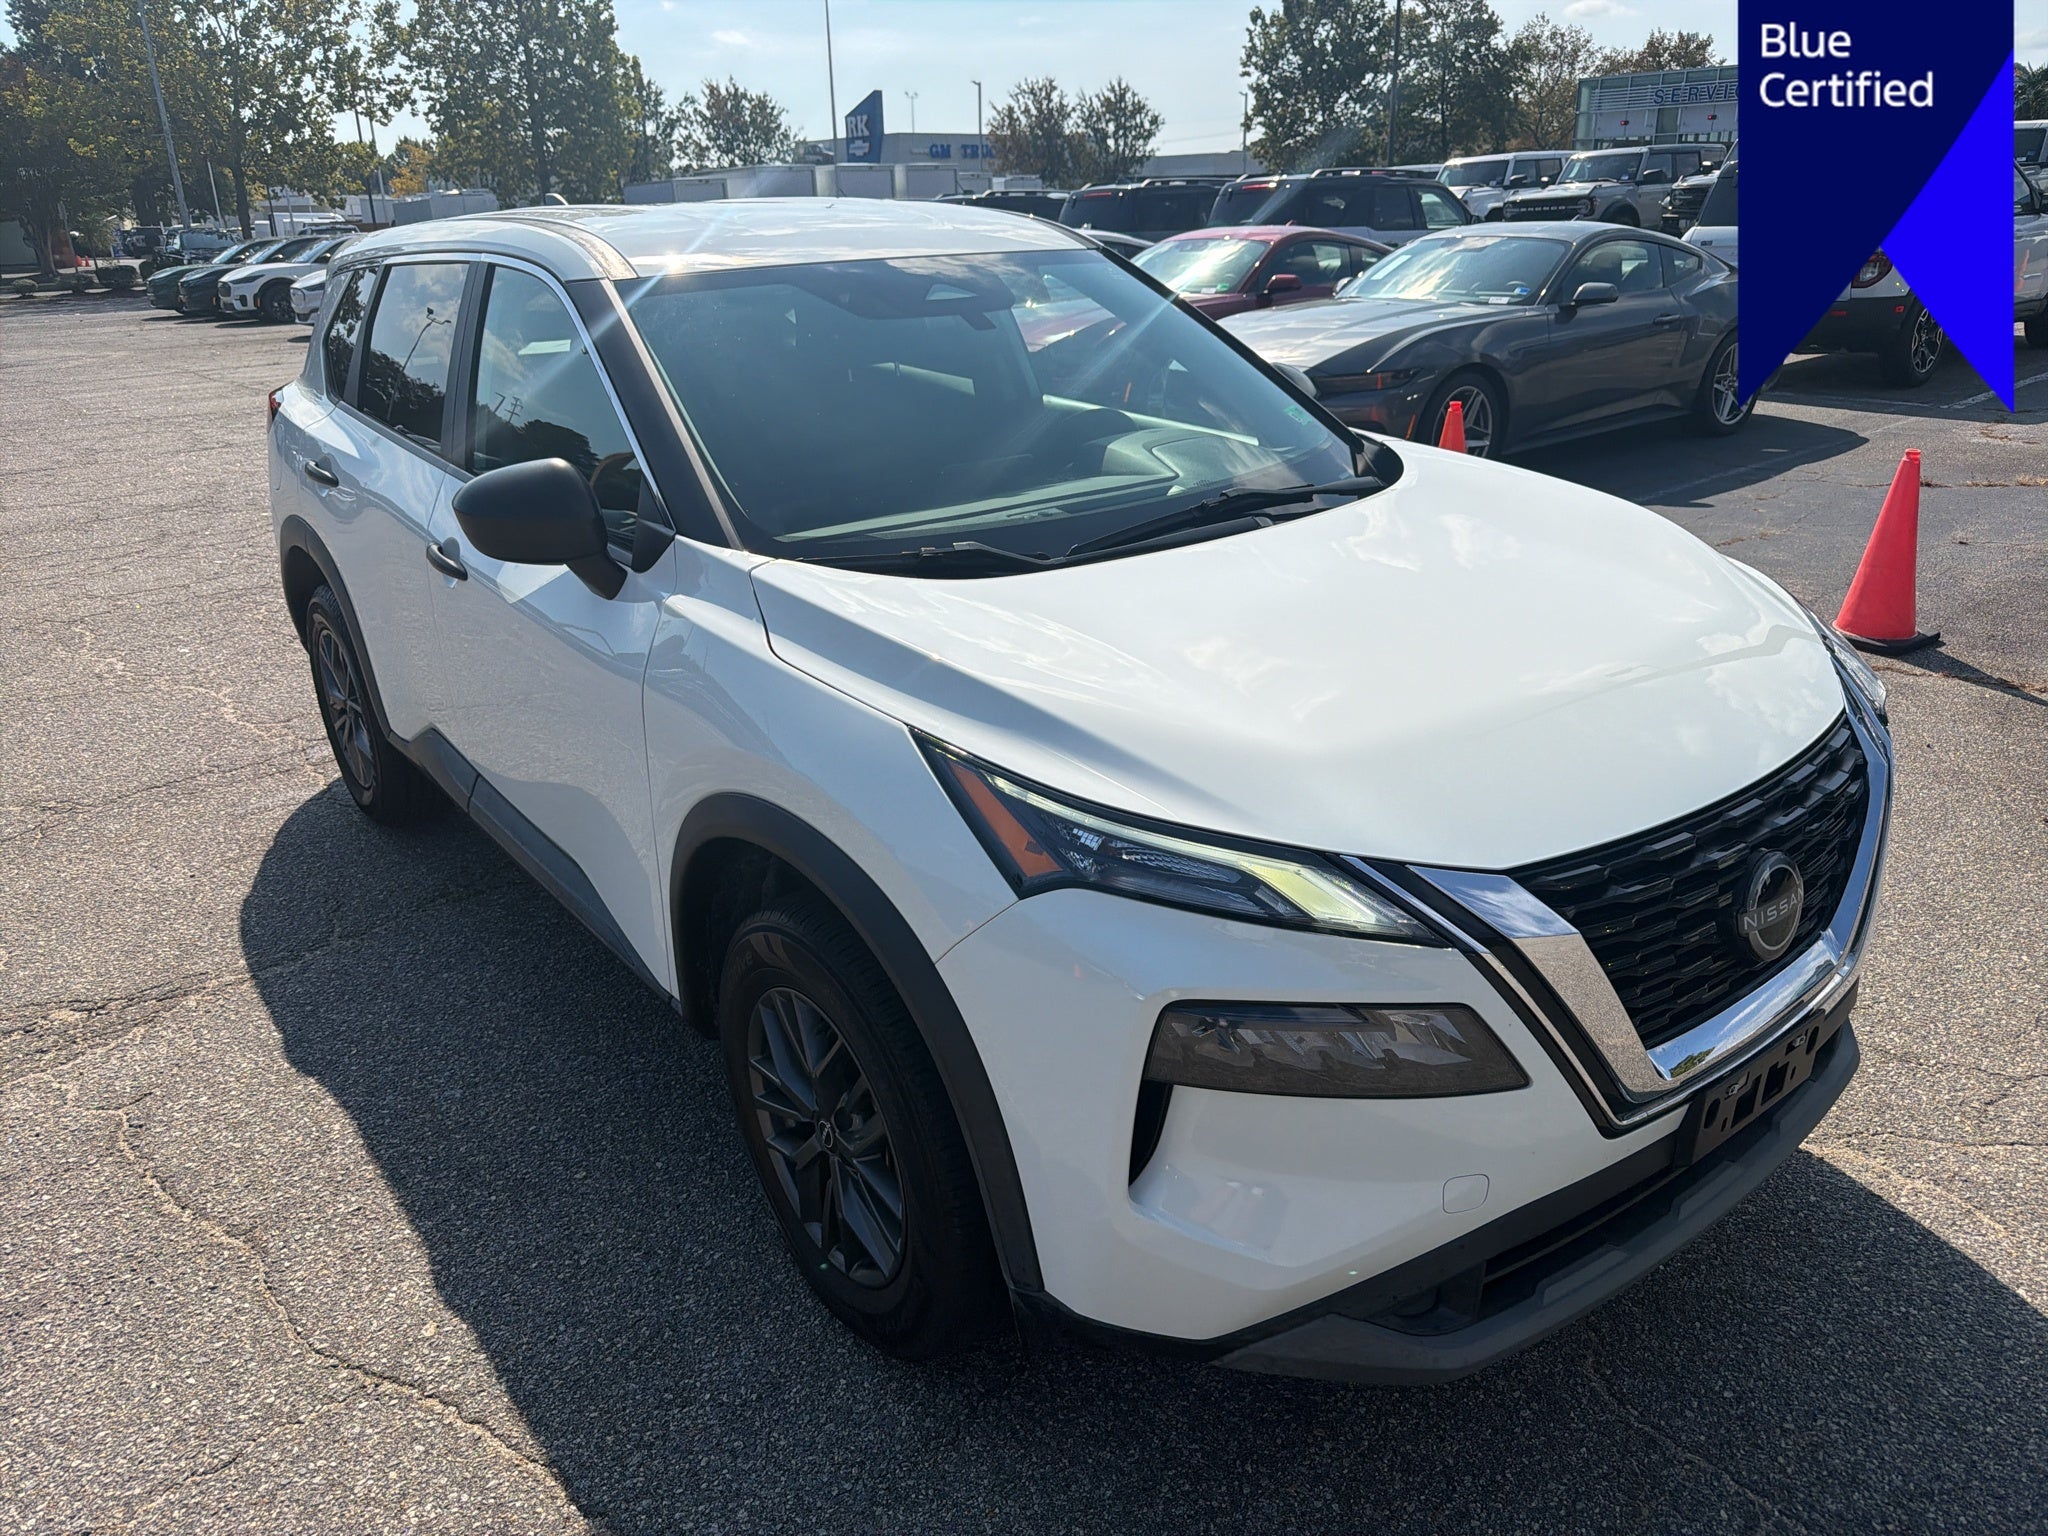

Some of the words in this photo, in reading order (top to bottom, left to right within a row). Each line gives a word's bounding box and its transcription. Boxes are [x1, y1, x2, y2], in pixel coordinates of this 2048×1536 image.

[1653, 83, 1738, 105] SERVI
[846, 115, 871, 138] RK
[929, 143, 952, 159] GM
[1743, 887, 1803, 931] NISSAN
